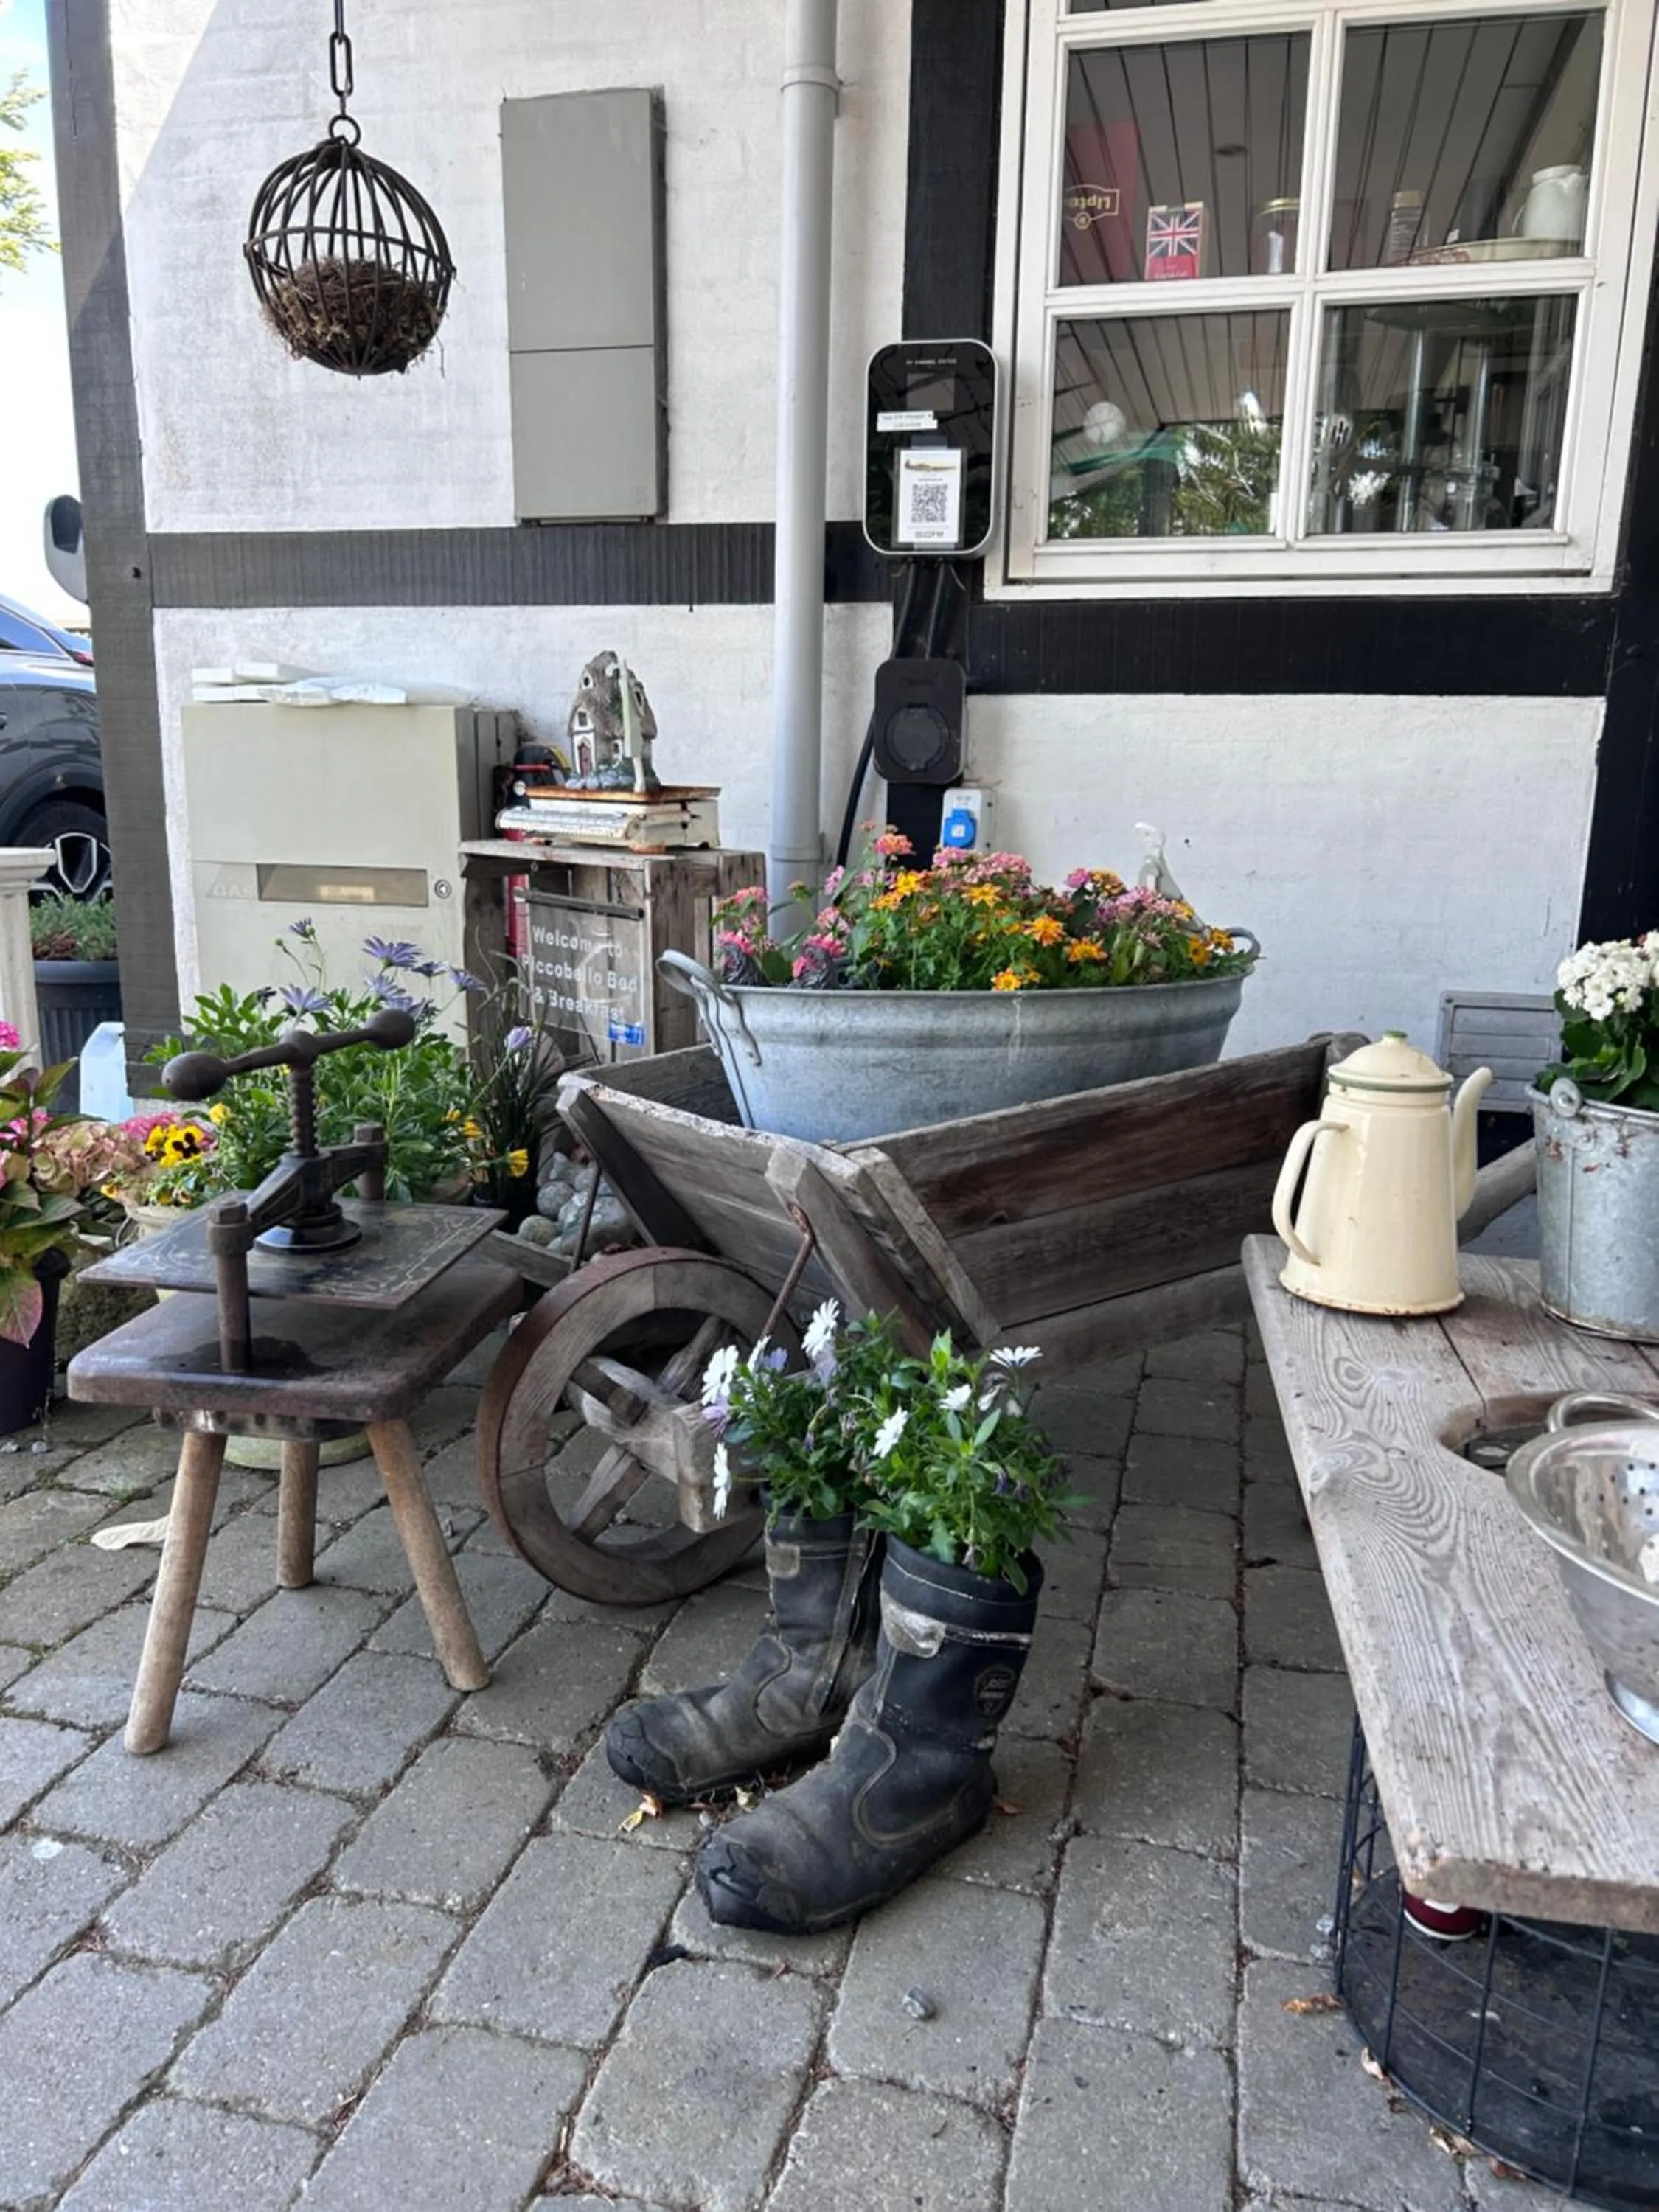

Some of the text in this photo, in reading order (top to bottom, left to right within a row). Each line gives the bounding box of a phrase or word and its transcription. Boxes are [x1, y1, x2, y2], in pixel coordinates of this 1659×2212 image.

[1065, 195, 1110, 209] Lipto
[608, 940, 622, 958] to
[608, 970, 637, 992] Bed
